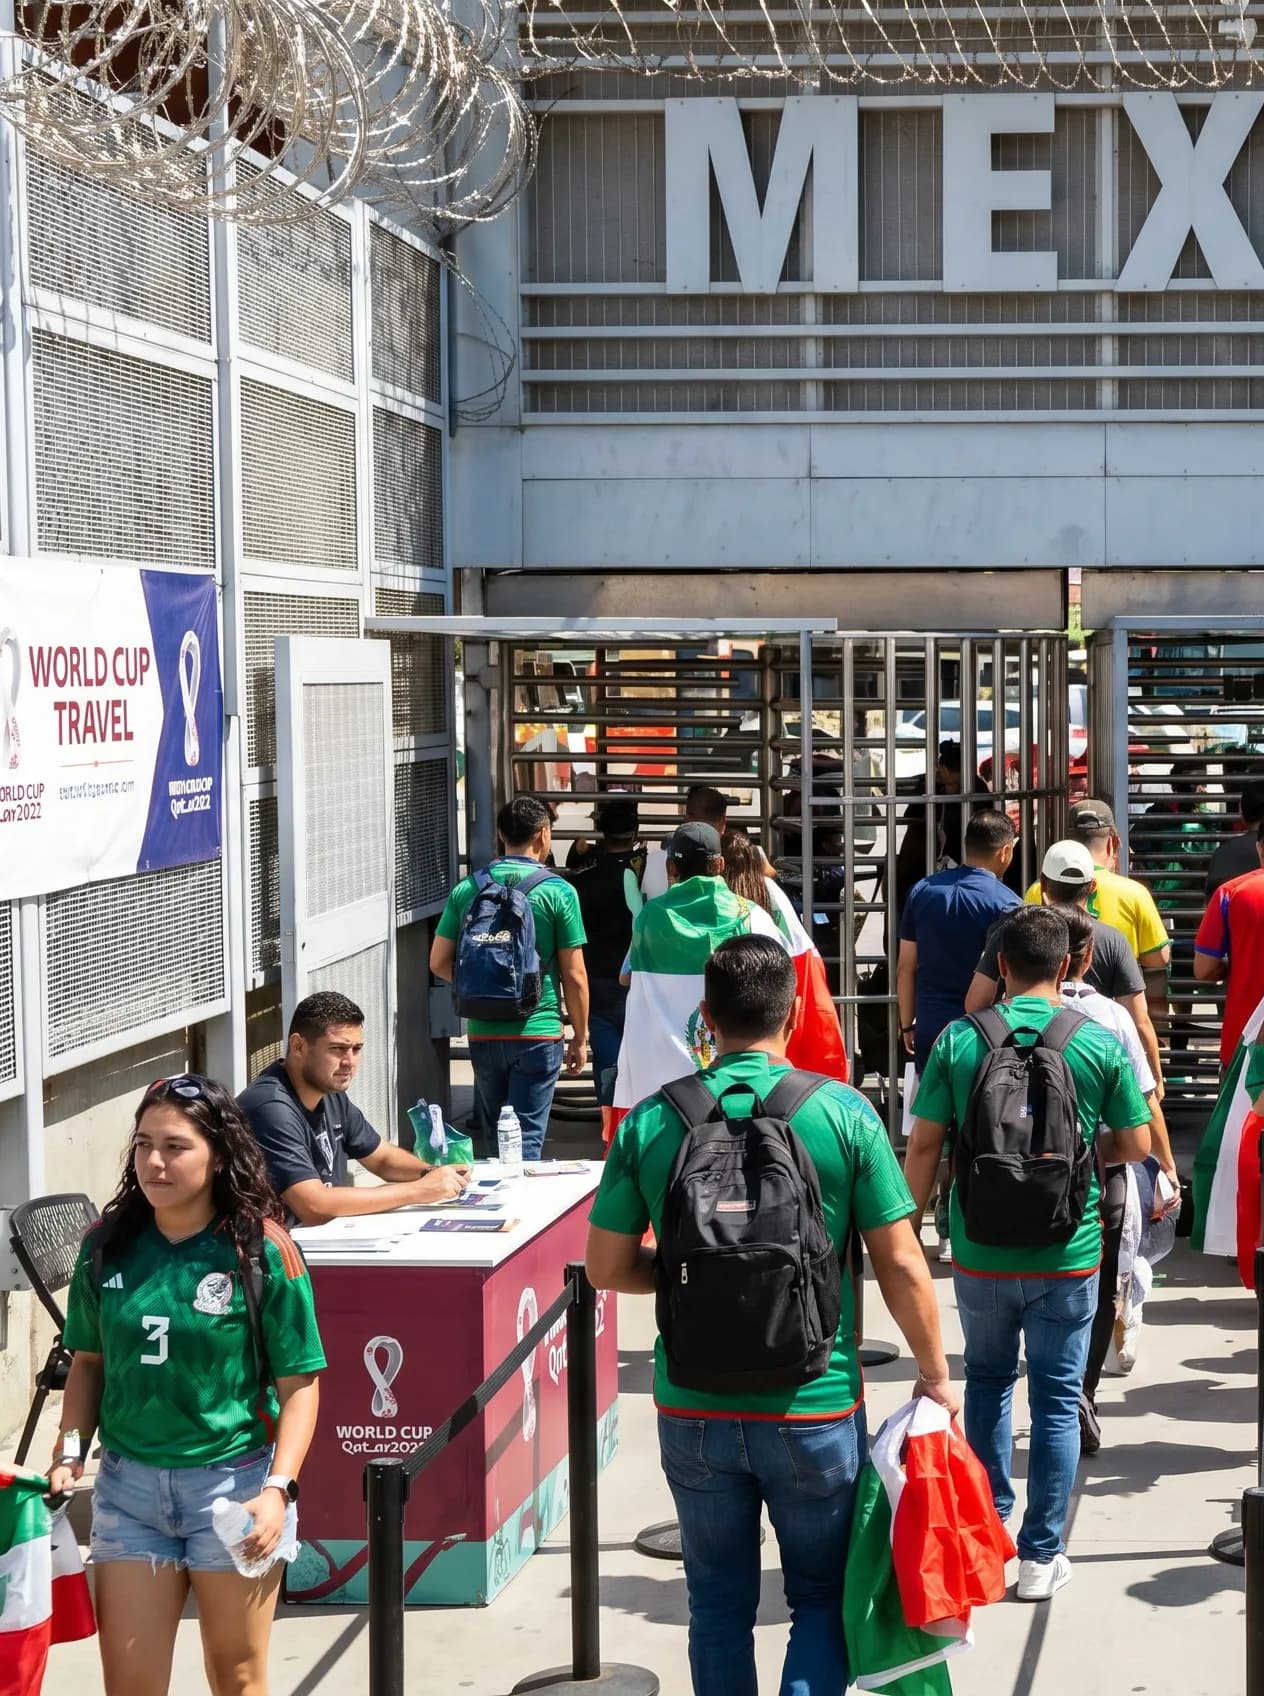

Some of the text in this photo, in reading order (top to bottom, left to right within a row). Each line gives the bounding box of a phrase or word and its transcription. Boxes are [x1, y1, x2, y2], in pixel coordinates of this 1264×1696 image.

[29, 646, 149, 687] WORLD CUP
[54, 700, 133, 745] TRAVEL
[0, 786, 25, 802] ORLD
[26, 783, 45, 800] CUP
[141, 1316, 169, 1365] 3
[336, 1425, 433, 1440] WORLD CUP
[341, 1440, 425, 1456] Qatar202
